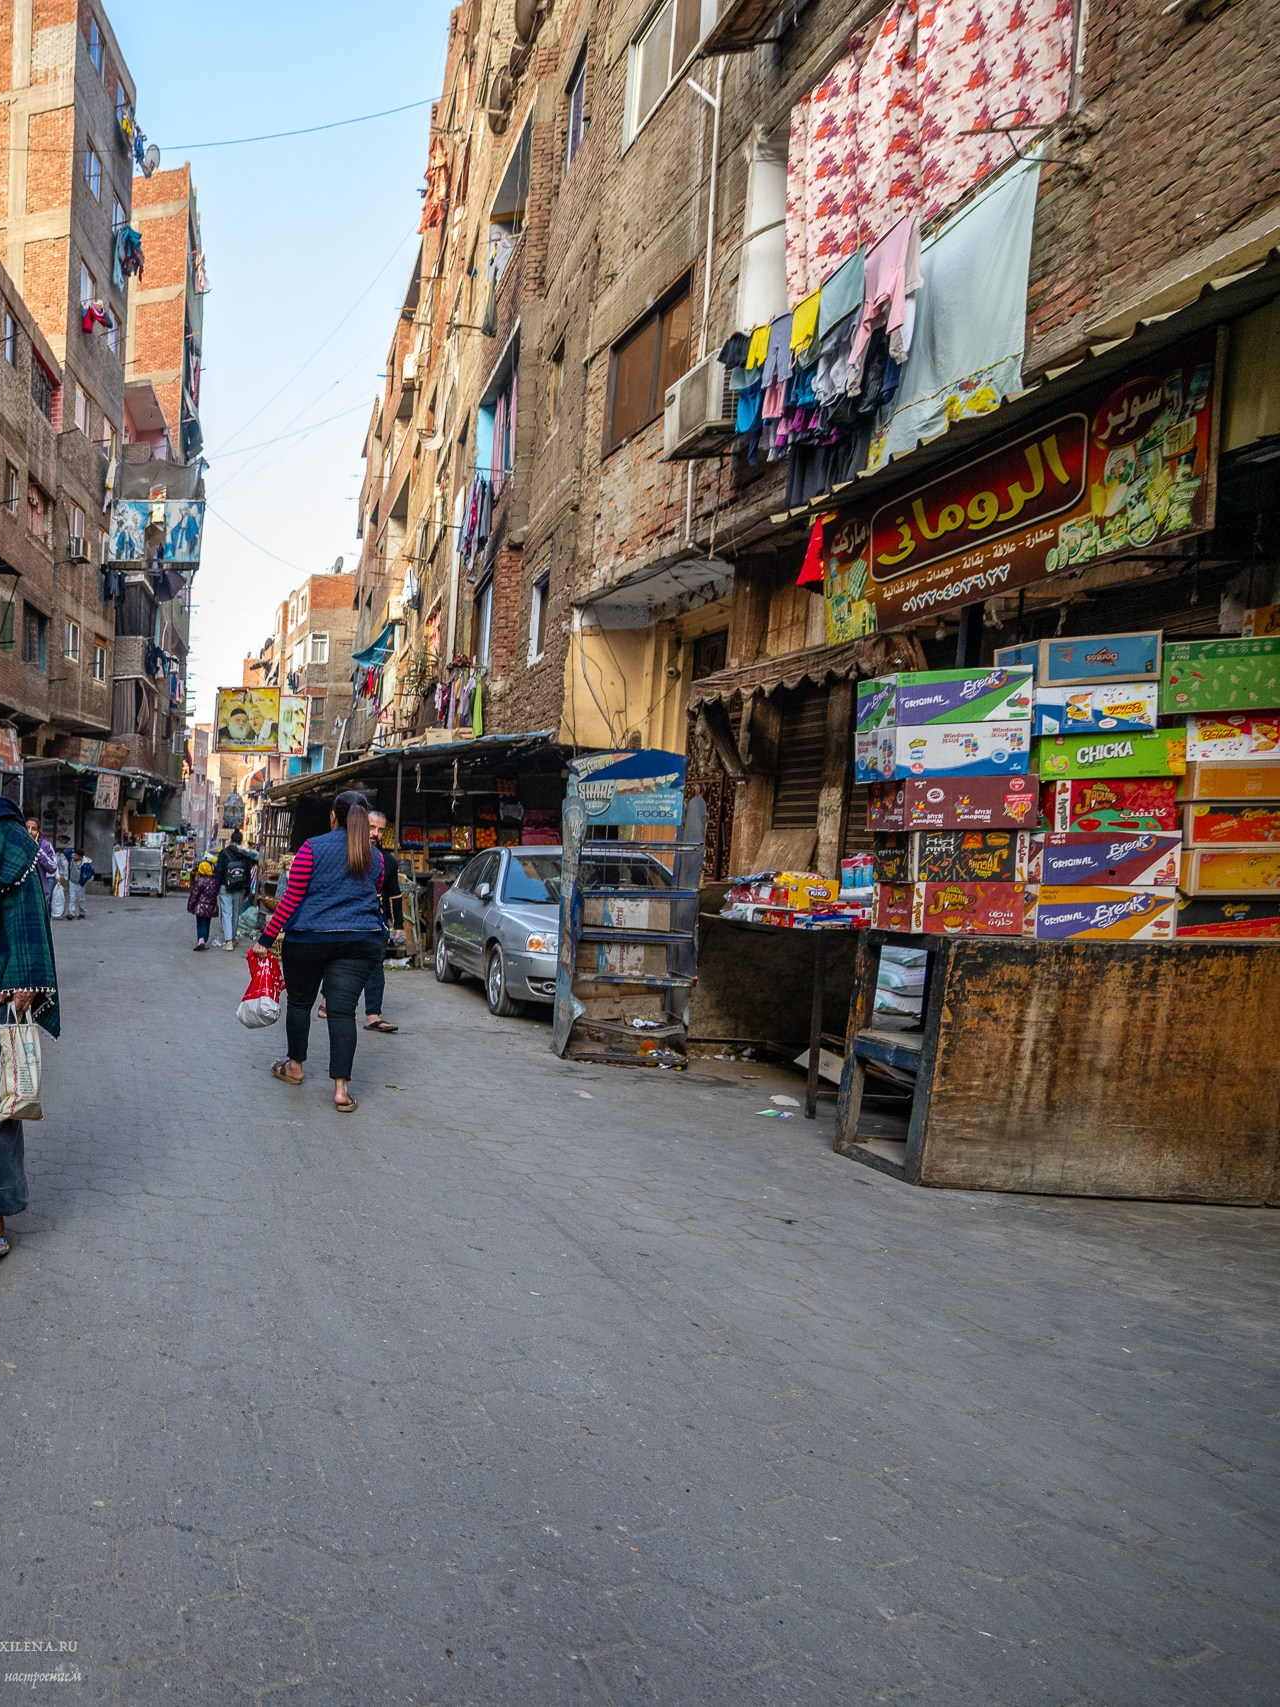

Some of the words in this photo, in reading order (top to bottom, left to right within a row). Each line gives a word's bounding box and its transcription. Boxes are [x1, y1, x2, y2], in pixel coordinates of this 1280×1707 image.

[1100, 387, 1164, 440] سوبر
[876, 434, 1071, 566] الرومانى
[830, 520, 869, 555] ماركت
[1025, 528, 1055, 548] عطارة
[962, 553, 984, 570] بقالة
[926, 565, 954, 583] مجمدات
[906, 578, 919, 592] مواد
[960, 670, 1001, 697] Break
[904, 695, 945, 709] ORIGINAL
[1076, 740, 1134, 763] CHICKA
[636, 810, 674, 819] FOODS
[1119, 808, 1167, 821] كاتشب
[1106, 835, 1151, 859] Break
[1052, 856, 1094, 869] ORIGINAL
[1044, 911, 1084, 925] ORIGINAL
[1089, 895, 1146, 925] Break
